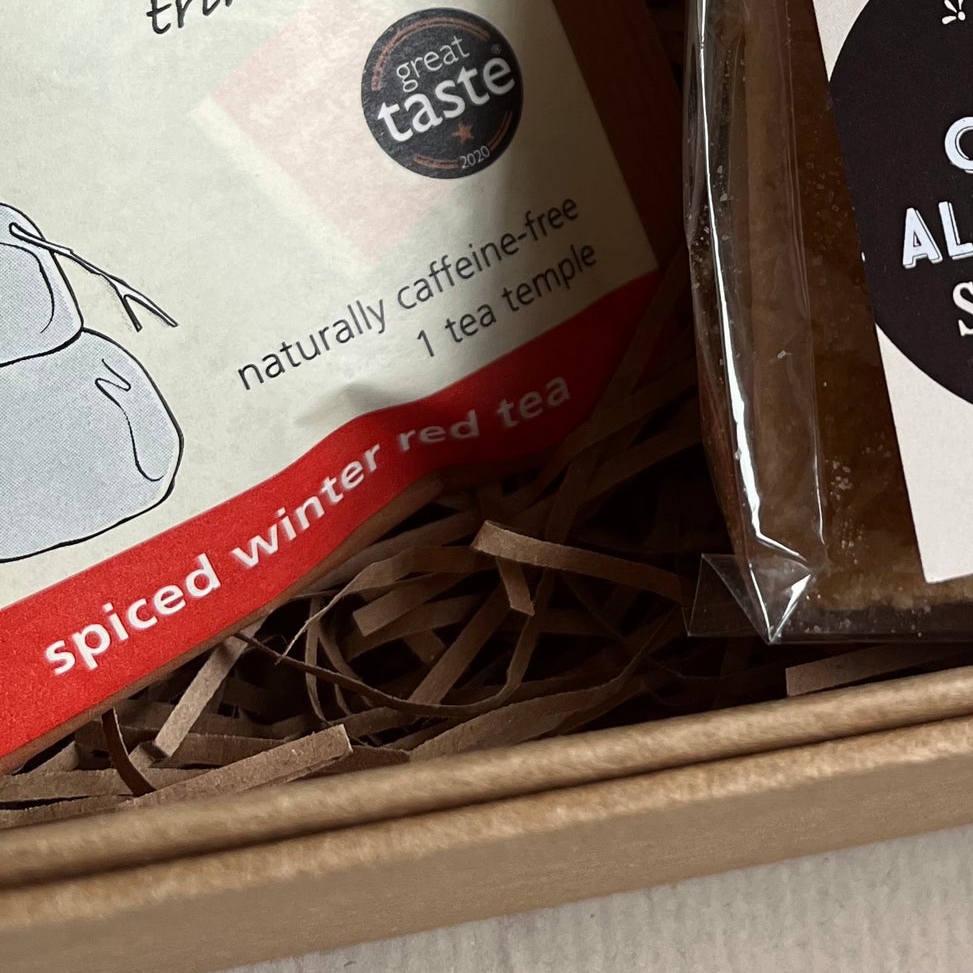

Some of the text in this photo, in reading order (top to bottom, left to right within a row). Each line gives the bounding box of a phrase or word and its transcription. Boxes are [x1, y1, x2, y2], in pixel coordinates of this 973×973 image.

[377, 57, 516, 143] taste
[395, 34, 470, 94] great
[459, 145, 491, 169] 2020
[237, 194, 580, 391] naturally caffeine-free
[415, 241, 598, 358] 1 tea temple
[44, 375, 572, 677] spiced winter red tea
